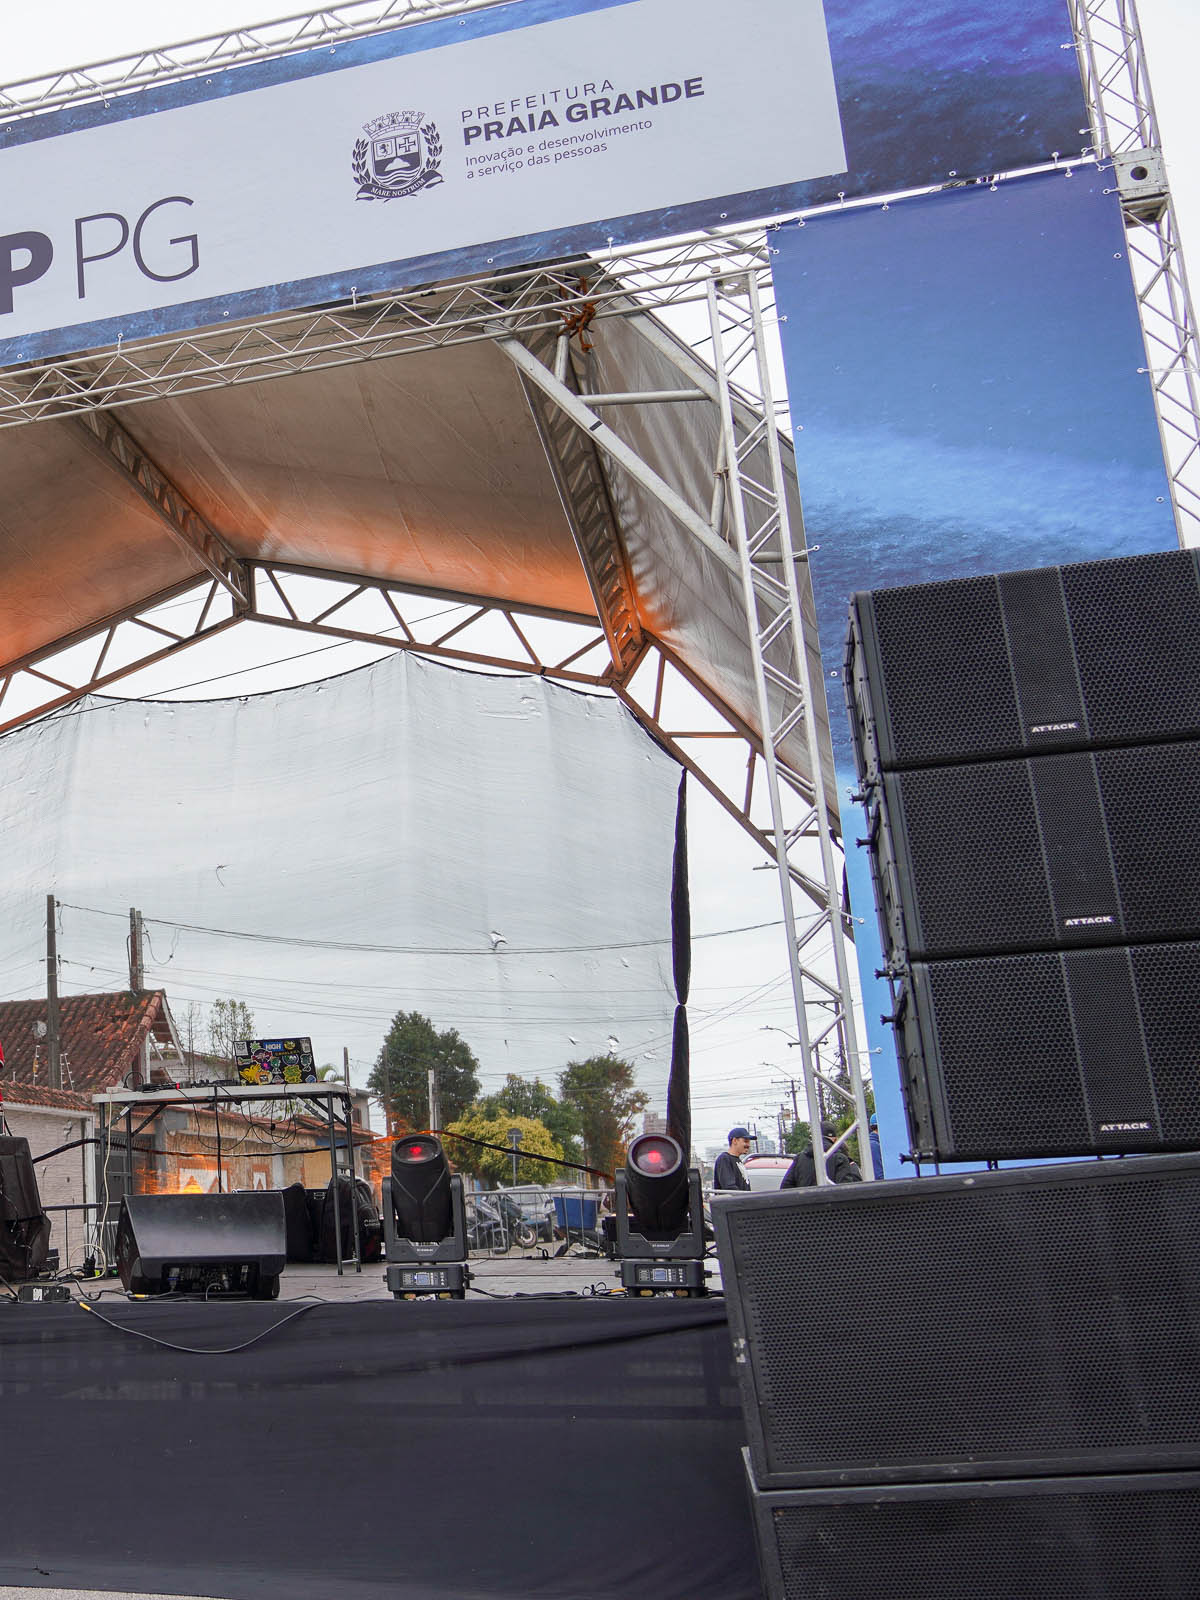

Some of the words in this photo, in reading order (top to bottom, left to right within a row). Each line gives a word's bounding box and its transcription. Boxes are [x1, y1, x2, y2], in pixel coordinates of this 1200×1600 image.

[461, 79, 614, 123] PREFEITURA
[463, 109, 560, 146] PRAIA
[565, 76, 705, 123] GRANDE
[465, 147, 523, 167] Inovação
[527, 145, 535, 153] e
[538, 120, 653, 151] desenvolvimento
[466, 170, 474, 179] a
[478, 161, 524, 177] serviço
[527, 156, 551, 167] das
[554, 142, 608, 163] pessoas
[392, 178, 426, 197] NOSTRUM
[75, 196, 200, 299] PG
[1031, 722, 1078, 733] ATTACK
[1065, 916, 1113, 926] ATTACK
[1100, 1122, 1149, 1131] ATTACK
